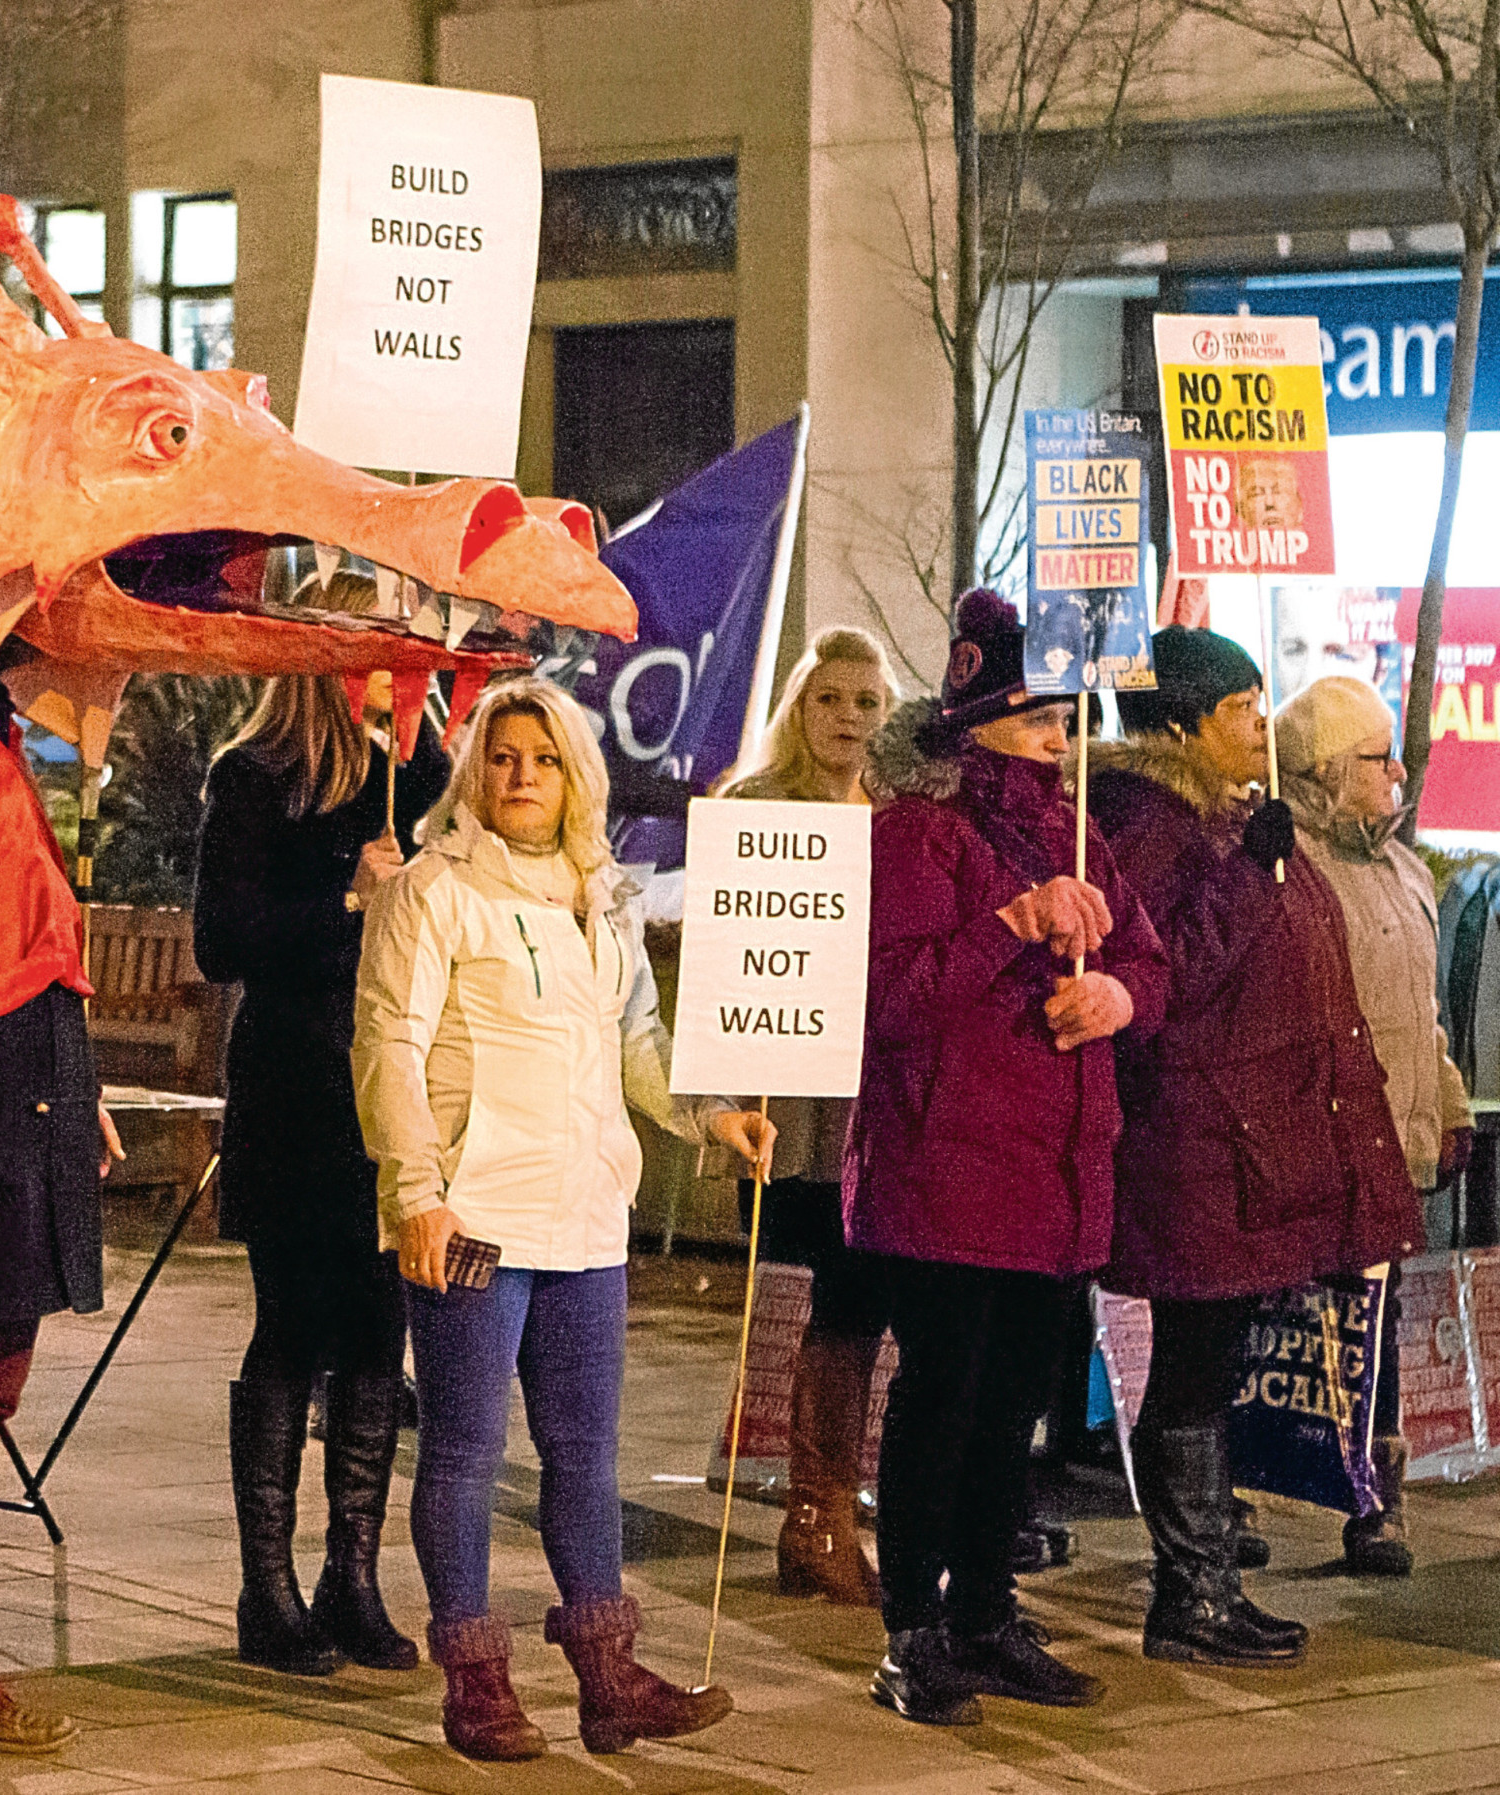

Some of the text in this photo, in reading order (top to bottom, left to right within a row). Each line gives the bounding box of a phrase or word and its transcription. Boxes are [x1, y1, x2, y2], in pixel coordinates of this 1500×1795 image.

[391, 164, 469, 196] BUILD
[371, 217, 483, 253] BRIDGES
[395, 275, 453, 305] NOT
[374, 328, 462, 361] WALLS
[1222, 331, 1279, 346] STAND UP
[1224, 346, 1286, 360] TO RACISM
[1178, 371, 1277, 406] NO TO
[1181, 408, 1307, 442] RACISM
[1049, 464, 1129, 495] BLACK
[1184, 456, 1232, 493] NO
[1055, 508, 1122, 540] LIVES
[1186, 493, 1232, 529] TO
[1189, 528, 1310, 566] TRUMP
[1040, 551, 1135, 587] MATTER
[737, 831, 827, 861] BUILD
[713, 888, 846, 920] BRIDGES
[742, 948, 811, 978] NOT
[719, 1005, 825, 1036] WALLS
